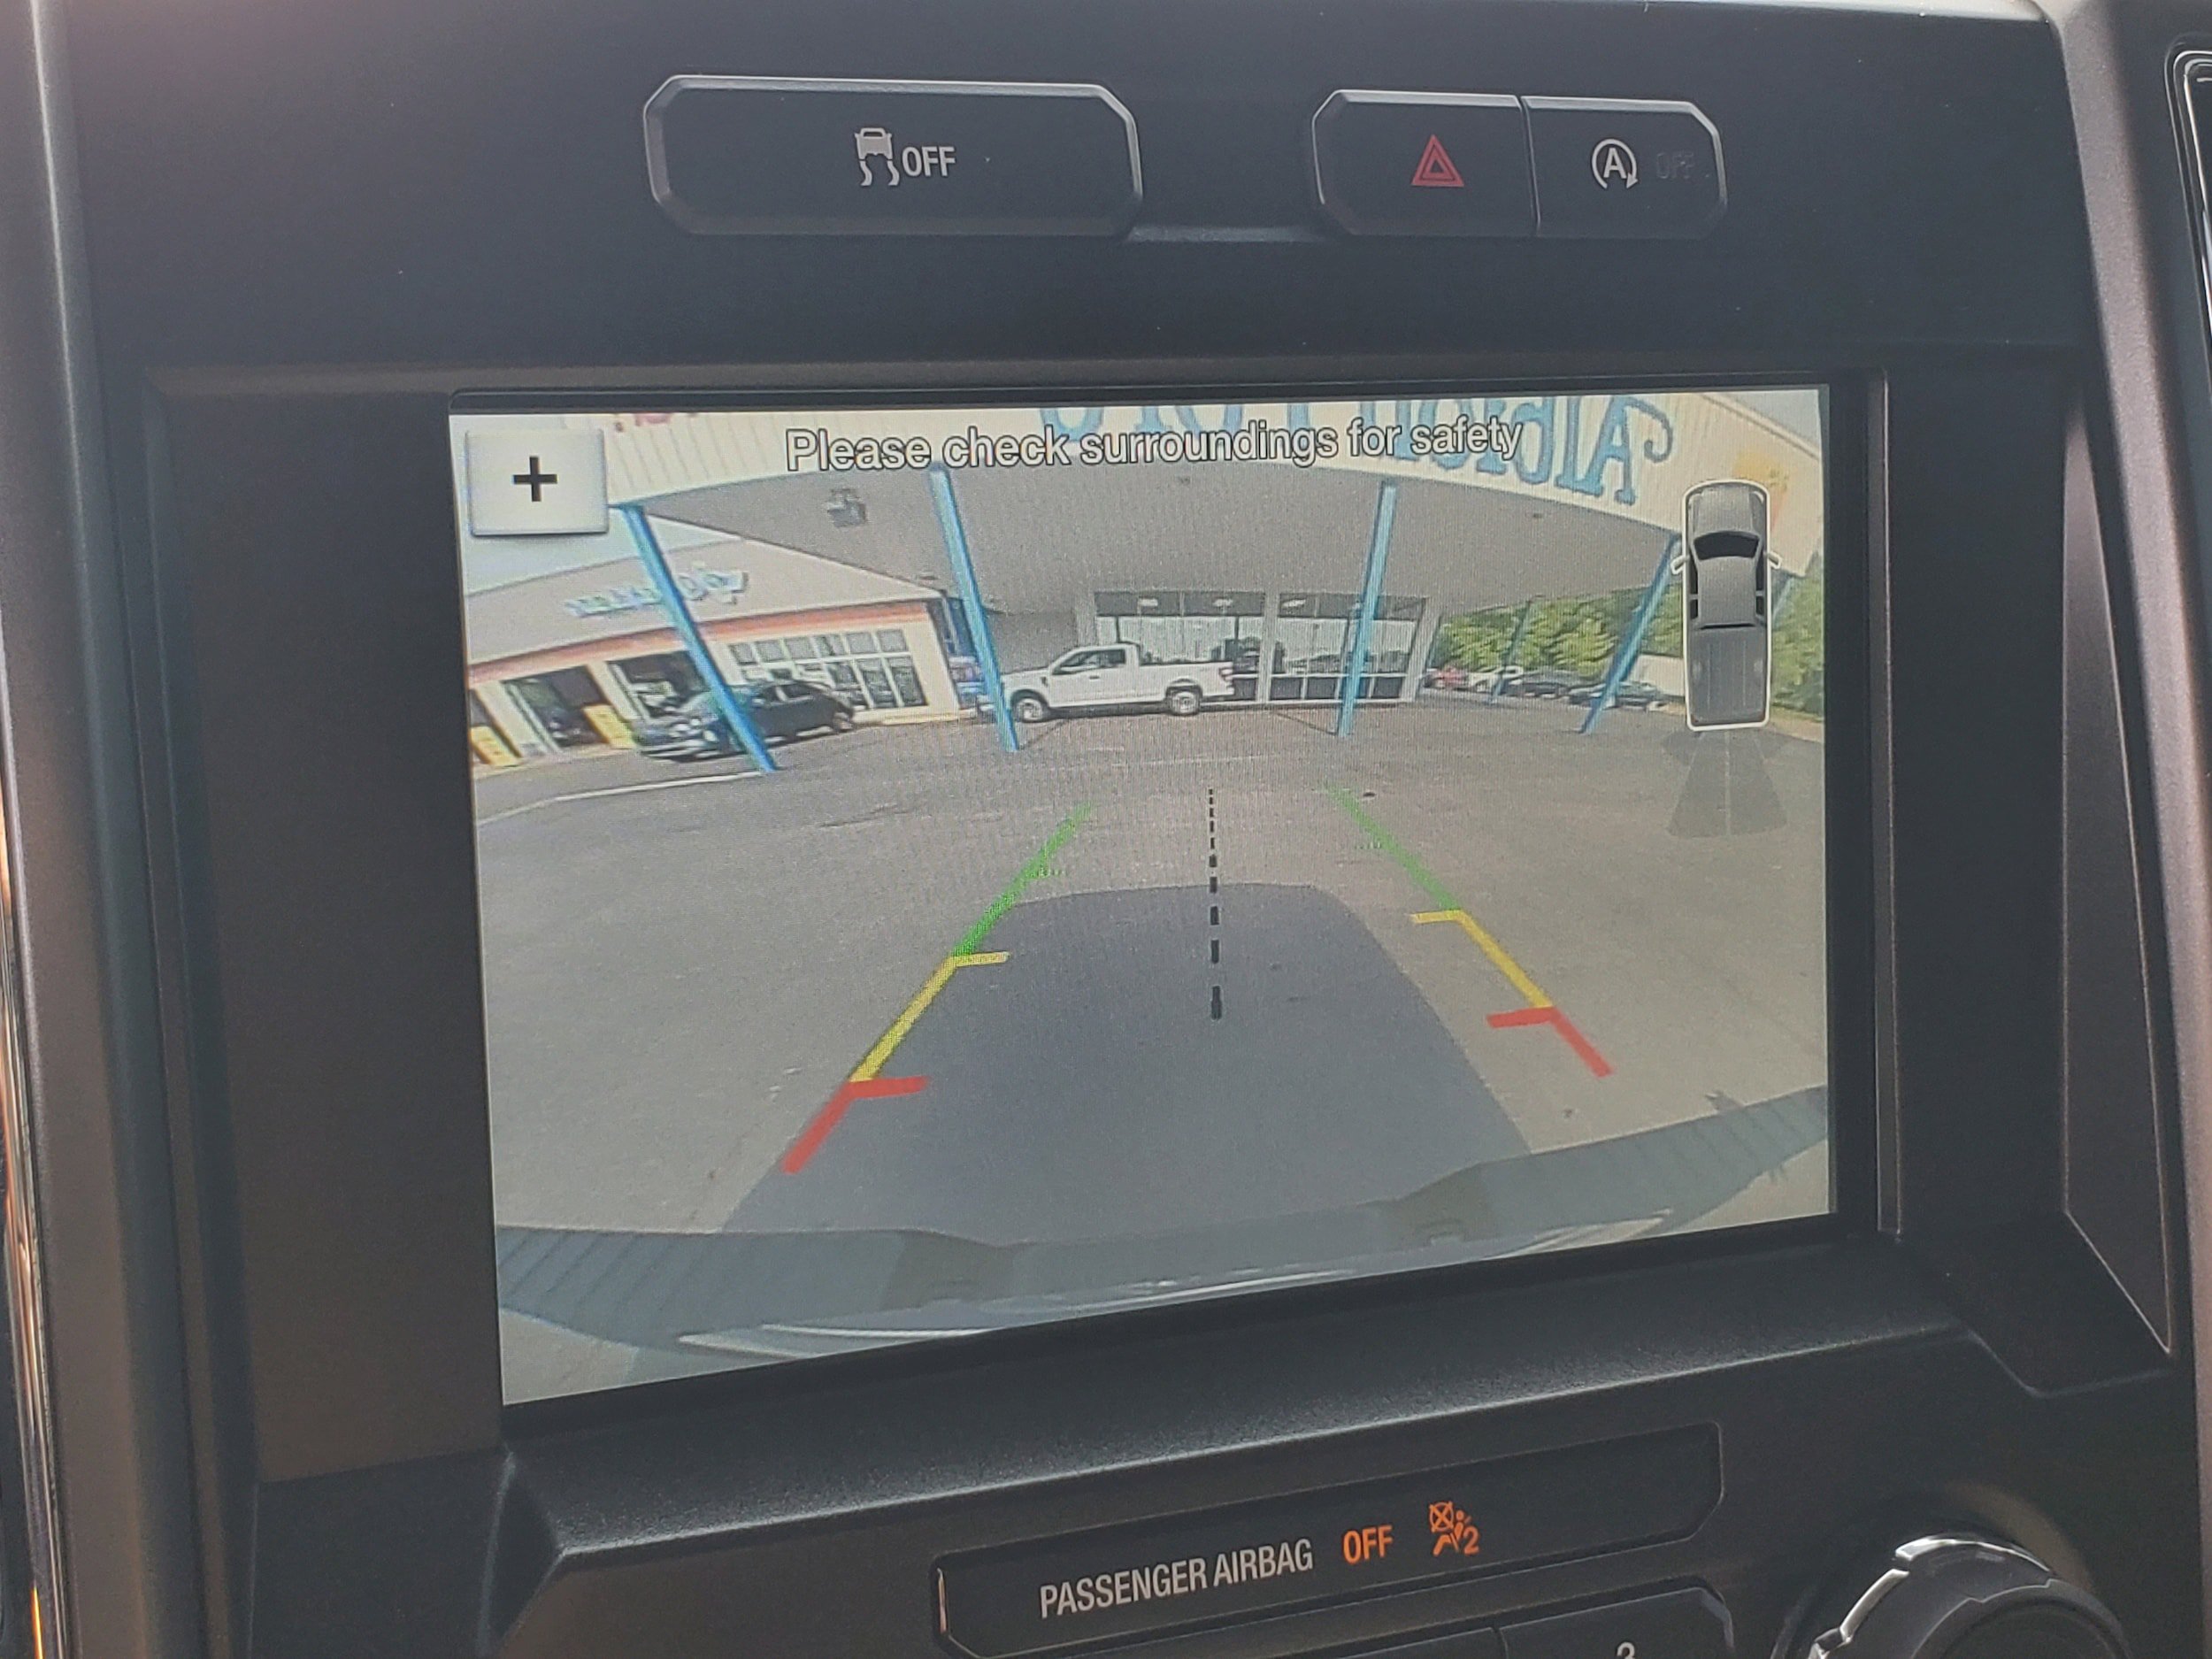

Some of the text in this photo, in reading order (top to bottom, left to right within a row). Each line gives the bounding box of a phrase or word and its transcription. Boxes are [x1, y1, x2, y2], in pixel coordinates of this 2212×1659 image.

[902, 146, 956, 177] OFF
[1602, 147, 1627, 179] A
[786, 428, 931, 471] Please
[942, 425, 1071, 467] check
[1079, 419, 1339, 468] surroundings
[1347, 417, 1402, 457] for
[1410, 414, 1524, 461] safety
[1040, 1557, 1208, 1618] PASSENGER
[1213, 1538, 1314, 1587] AIRBAG
[1342, 1525, 1394, 1564] OFF
